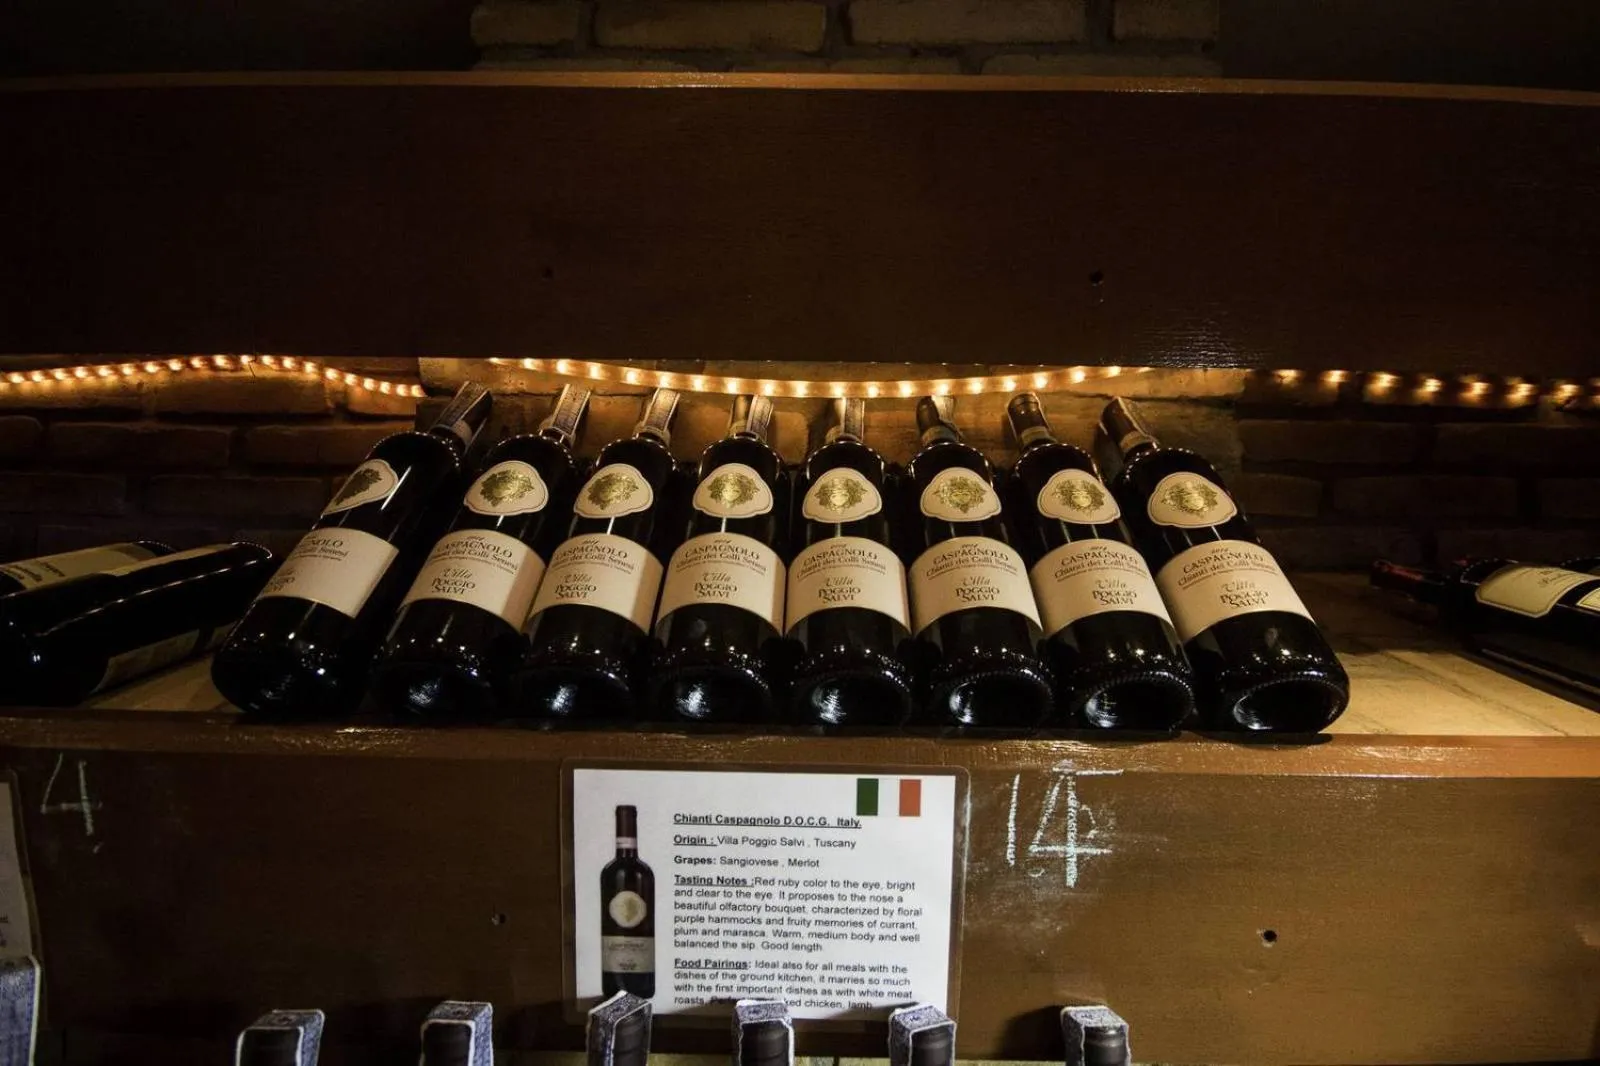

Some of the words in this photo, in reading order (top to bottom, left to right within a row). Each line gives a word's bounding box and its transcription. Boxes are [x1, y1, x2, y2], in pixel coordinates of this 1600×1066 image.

[685, 544, 760, 559] CASPAGNOLO
[803, 549, 878, 566] CASPAGNOLO
[933, 548, 1009, 565] CASPAGNOLO
[1061, 551, 1138, 566] CASPAGNOLO
[1183, 552, 1264, 574] CASPAGNOLO
[926, 562, 953, 577] Chianti
[1054, 563, 1085, 578] Chianti
[432, 578, 476, 589] POGGIO
[1177, 568, 1209, 586] Chianti
[432, 585, 465, 594] SALVI
[555, 584, 597, 593] POGGIO
[694, 582, 737, 592] POGGIO
[818, 587, 861, 598] POGGIO
[955, 586, 1001, 597] POGGIO
[556, 592, 588, 600] SALVI
[697, 590, 730, 599] SALVI
[822, 594, 854, 604] SALVI
[961, 594, 994, 602] SALVI
[1092, 590, 1137, 600] POGGIO
[1220, 590, 1270, 604] POGGIO
[1100, 597, 1134, 606] SALVI
[1230, 598, 1266, 609] SALVI
[40, 752, 103, 836] 4
[674, 813, 712, 824] Chianti
[716, 814, 780, 826] Caspagnolo
[784, 816, 830, 827] D.O.C.G.
[717, 836, 738, 845] Villa
[742, 836, 777, 847] Poggio
[780, 837, 804, 847] Salvi
[814, 838, 856, 849] Tuscany
[674, 855, 716, 865] Grapes:
[720, 856, 779, 867] Sangiovese
[788, 859, 819, 867] Merlot
[674, 875, 712, 886] Tasting
[778, 878, 799, 888] ruby
[803, 879, 827, 888] color
[831, 879, 840, 888] to
[843, 880, 859, 888] the
[887, 881, 915, 892] bright
[674, 889, 692, 897] and
[696, 889, 720, 897] clear
[724, 890, 732, 898] to
[736, 890, 751, 898] the
[779, 890, 785, 899] It
[789, 892, 834, 902] proposes
[838, 893, 847, 901] to
[850, 893, 865, 902] the
[674, 902, 716, 910] beautiful
[720, 902, 761, 913] olfactory
[812, 906, 879, 915] characterized
[883, 907, 894, 917] by
[898, 907, 922, 916] floral
[674, 915, 705, 924] purple
[708, 915, 762, 925] hammocks
[766, 917, 784, 925] and
[788, 917, 811, 928] fruity
[815, 919, 864, 928] memories
[867, 920, 877, 928] of
[674, 927, 698, 937] plum
[701, 928, 719, 936] and
[808, 931, 847, 939] medium
[851, 933, 875, 943] body
[879, 933, 897, 941] and
[900, 934, 920, 942] well
[674, 939, 719, 948] balanced
[722, 941, 737, 949] the
[761, 941, 788, 950] Good
[674, 958, 701, 969] Food
[705, 959, 751, 970] Pairings:
[755, 960, 779, 968] Ideal
[783, 960, 802, 970] also
[805, 962, 818, 970] for
[822, 962, 833, 971] all
[836, 963, 865, 972] meals
[869, 964, 888, 972] with
[892, 965, 908, 973] the
[674, 971, 706, 980] dishes
[709, 972, 719, 980] of
[722, 972, 737, 980] the
[740, 973, 774, 982] ground
[828, 976, 864, 984] marries
[883, 977, 910, 986] much
[674, 984, 693, 992] with
[697, 984, 712, 992] the
[715, 984, 733, 992] first
[737, 985, 782, 994] important
[786, 986, 817, 995] dishes
[836, 988, 855, 997] with
[859, 989, 884, 997] white
[887, 991, 912, 999] meat
